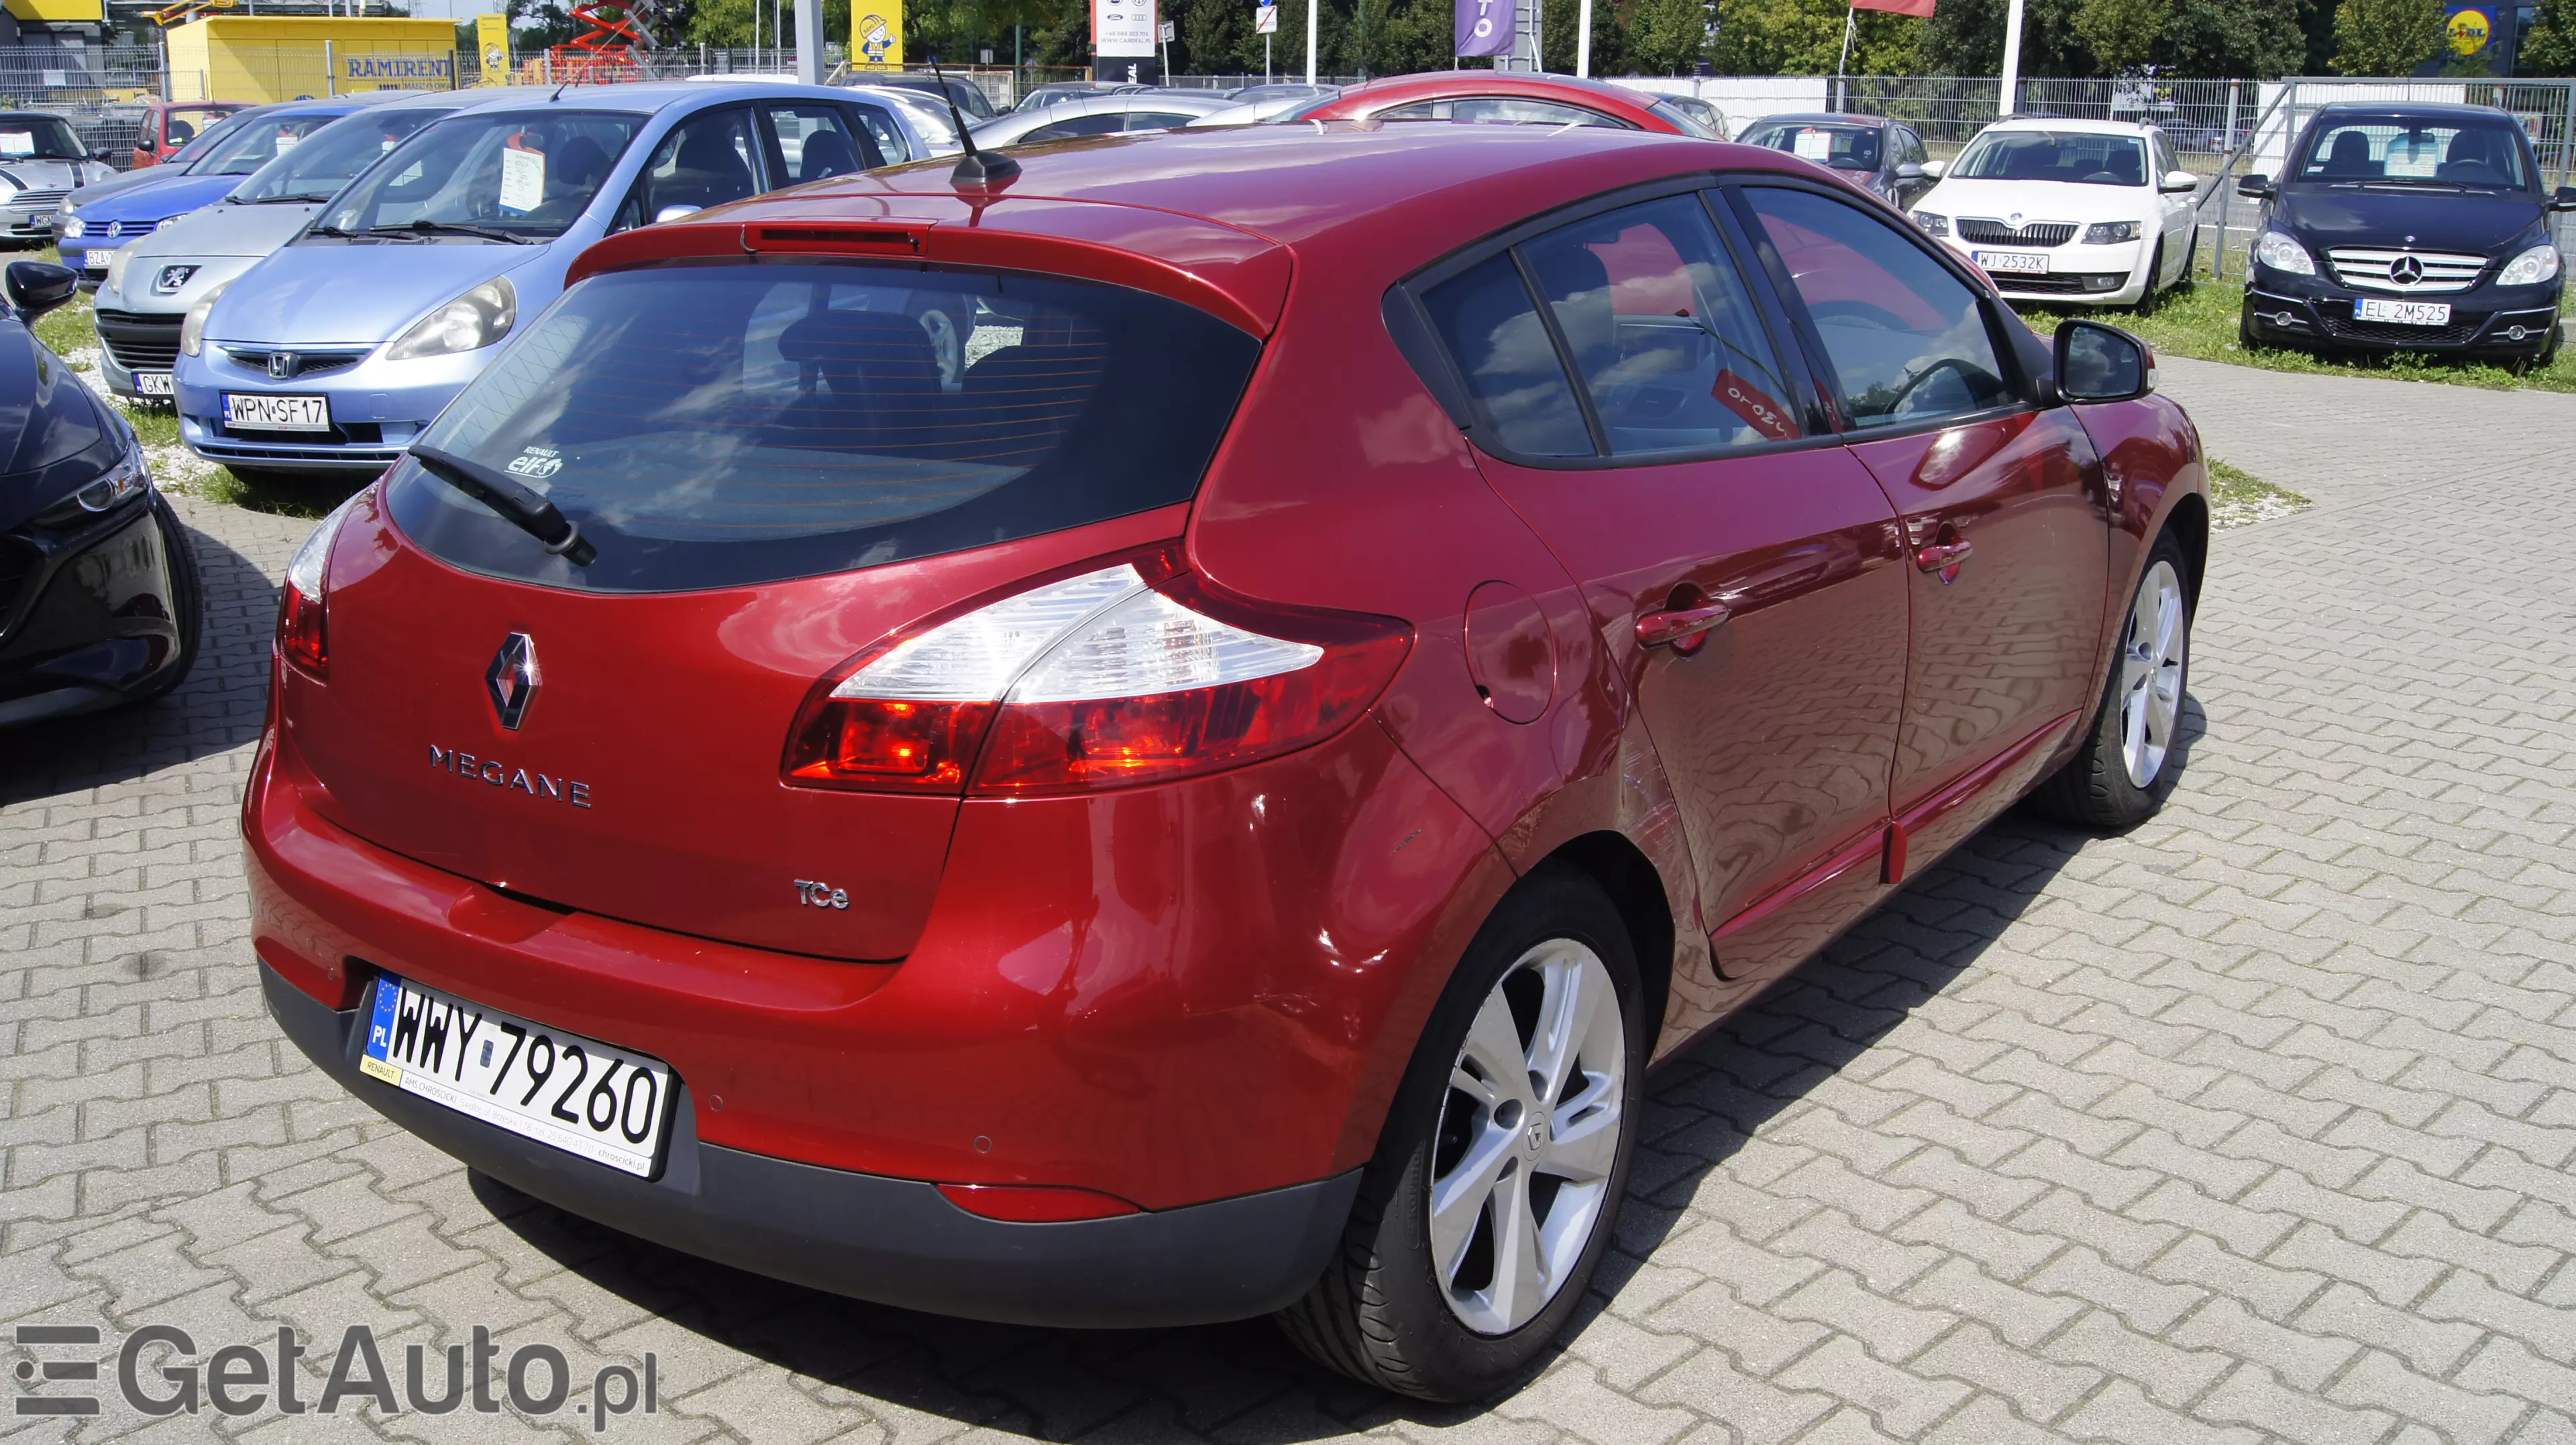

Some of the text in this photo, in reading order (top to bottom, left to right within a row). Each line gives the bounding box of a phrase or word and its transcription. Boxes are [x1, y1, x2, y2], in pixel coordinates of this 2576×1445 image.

[1981, 254, 2044, 269] WJ 2532K
[2366, 302, 2447, 321] EL 2M525
[143, 376, 172, 392] GKW
[232, 398, 322, 423] WPN SF17
[523, 446, 559, 458] RENAULT
[431, 744, 592, 808] MEGANE
[794, 878, 849, 909] TCe
[372, 1025, 387, 1047] PL
[367, 1061, 394, 1079] RENAULT
[393, 987, 657, 1144] WWY 79260
[405, 1077, 417, 1088] AMS
[598, 1149, 645, 1171] chroscicki.pl
